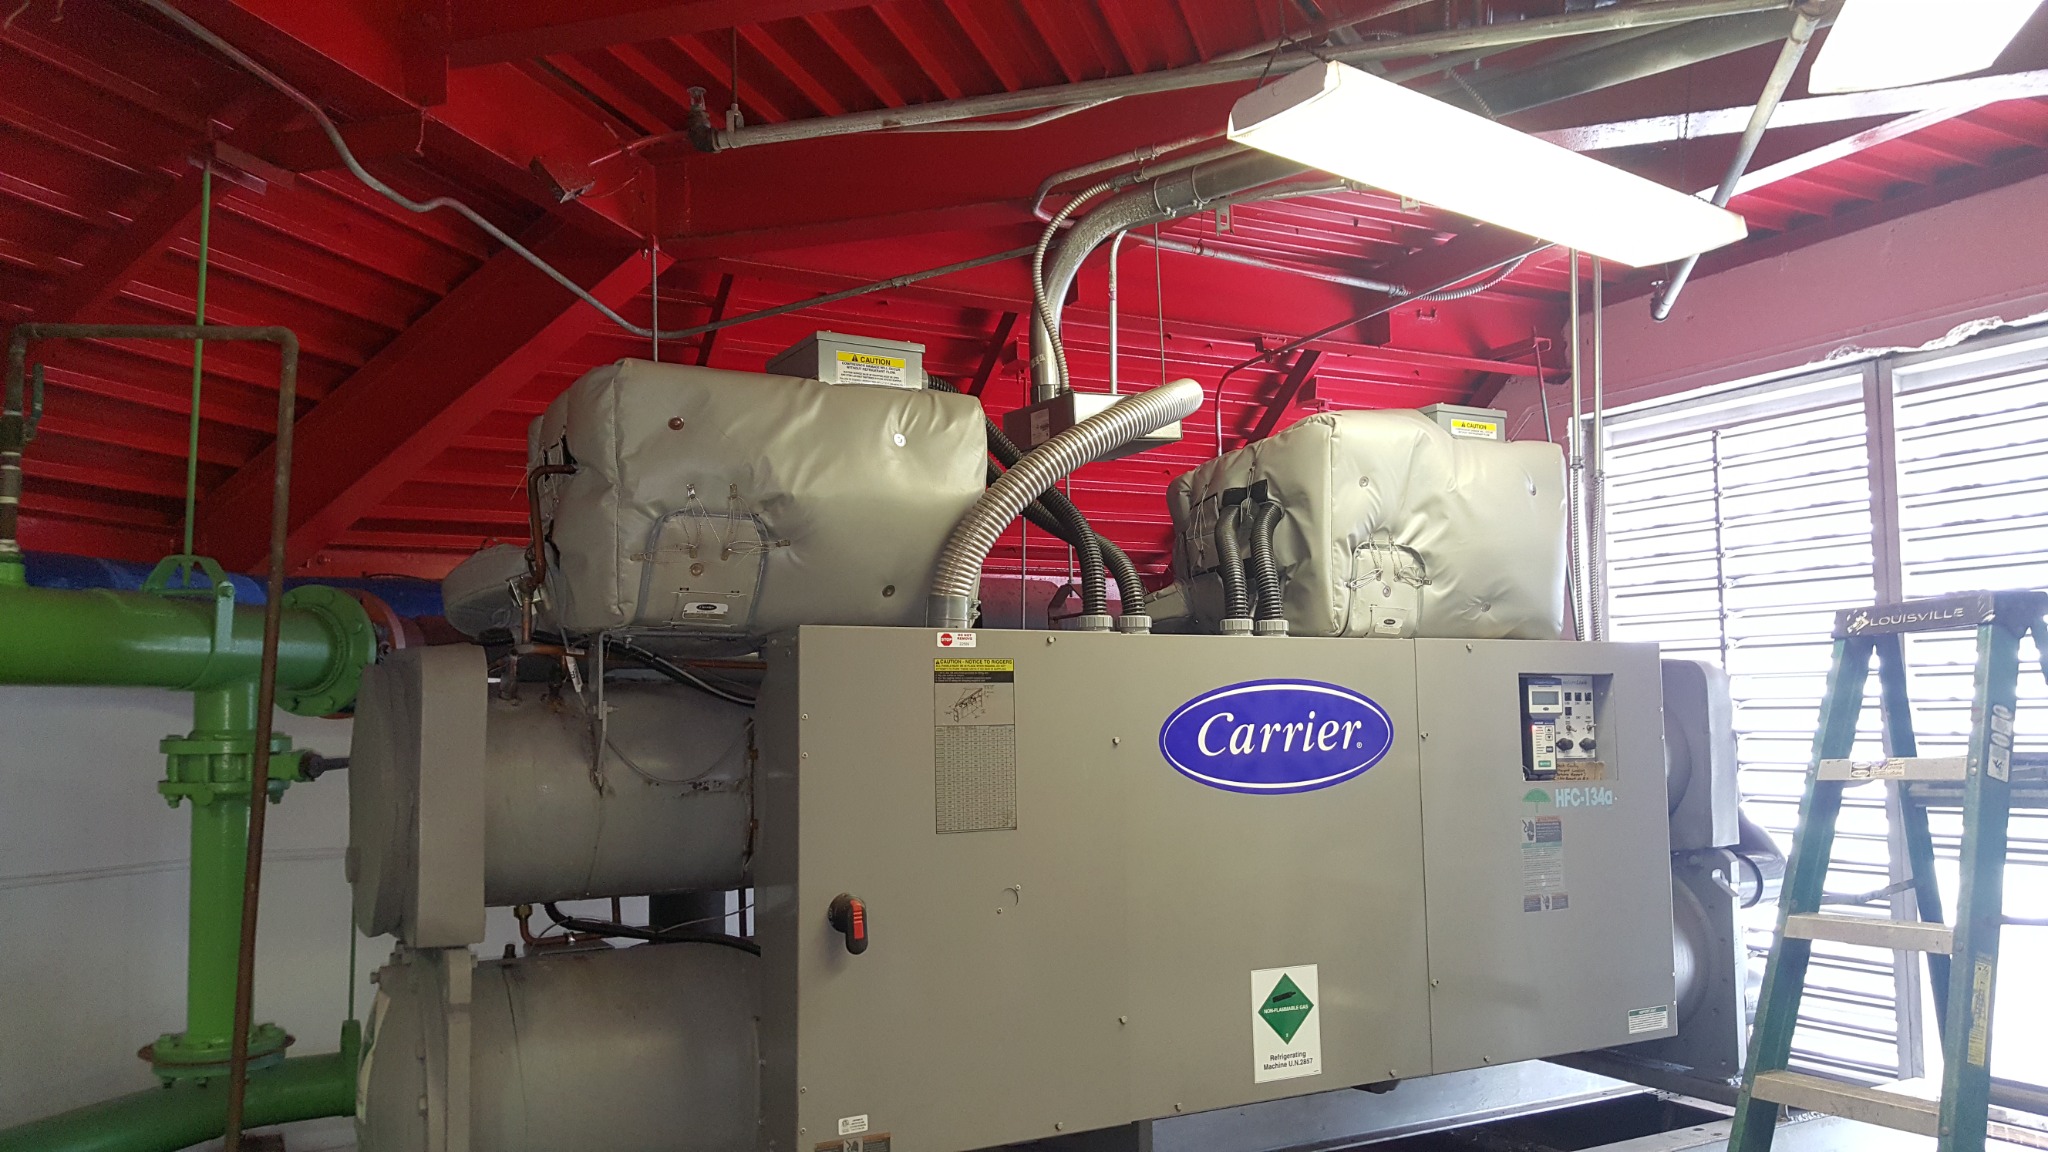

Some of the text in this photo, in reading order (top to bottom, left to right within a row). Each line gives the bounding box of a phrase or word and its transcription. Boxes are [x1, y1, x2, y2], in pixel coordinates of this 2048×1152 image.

[860, 356, 891, 366] CAUTION
[1467, 422, 1487, 430] CAUTION
[1869, 607, 1964, 627] LOUISVILLE
[1197, 710, 1362, 757] Carrier
[1555, 786, 1613, 808] HFC-134a
[1269, 1051, 1307, 1062] Refrigerating
[1263, 1060, 1288, 1071] Machine
